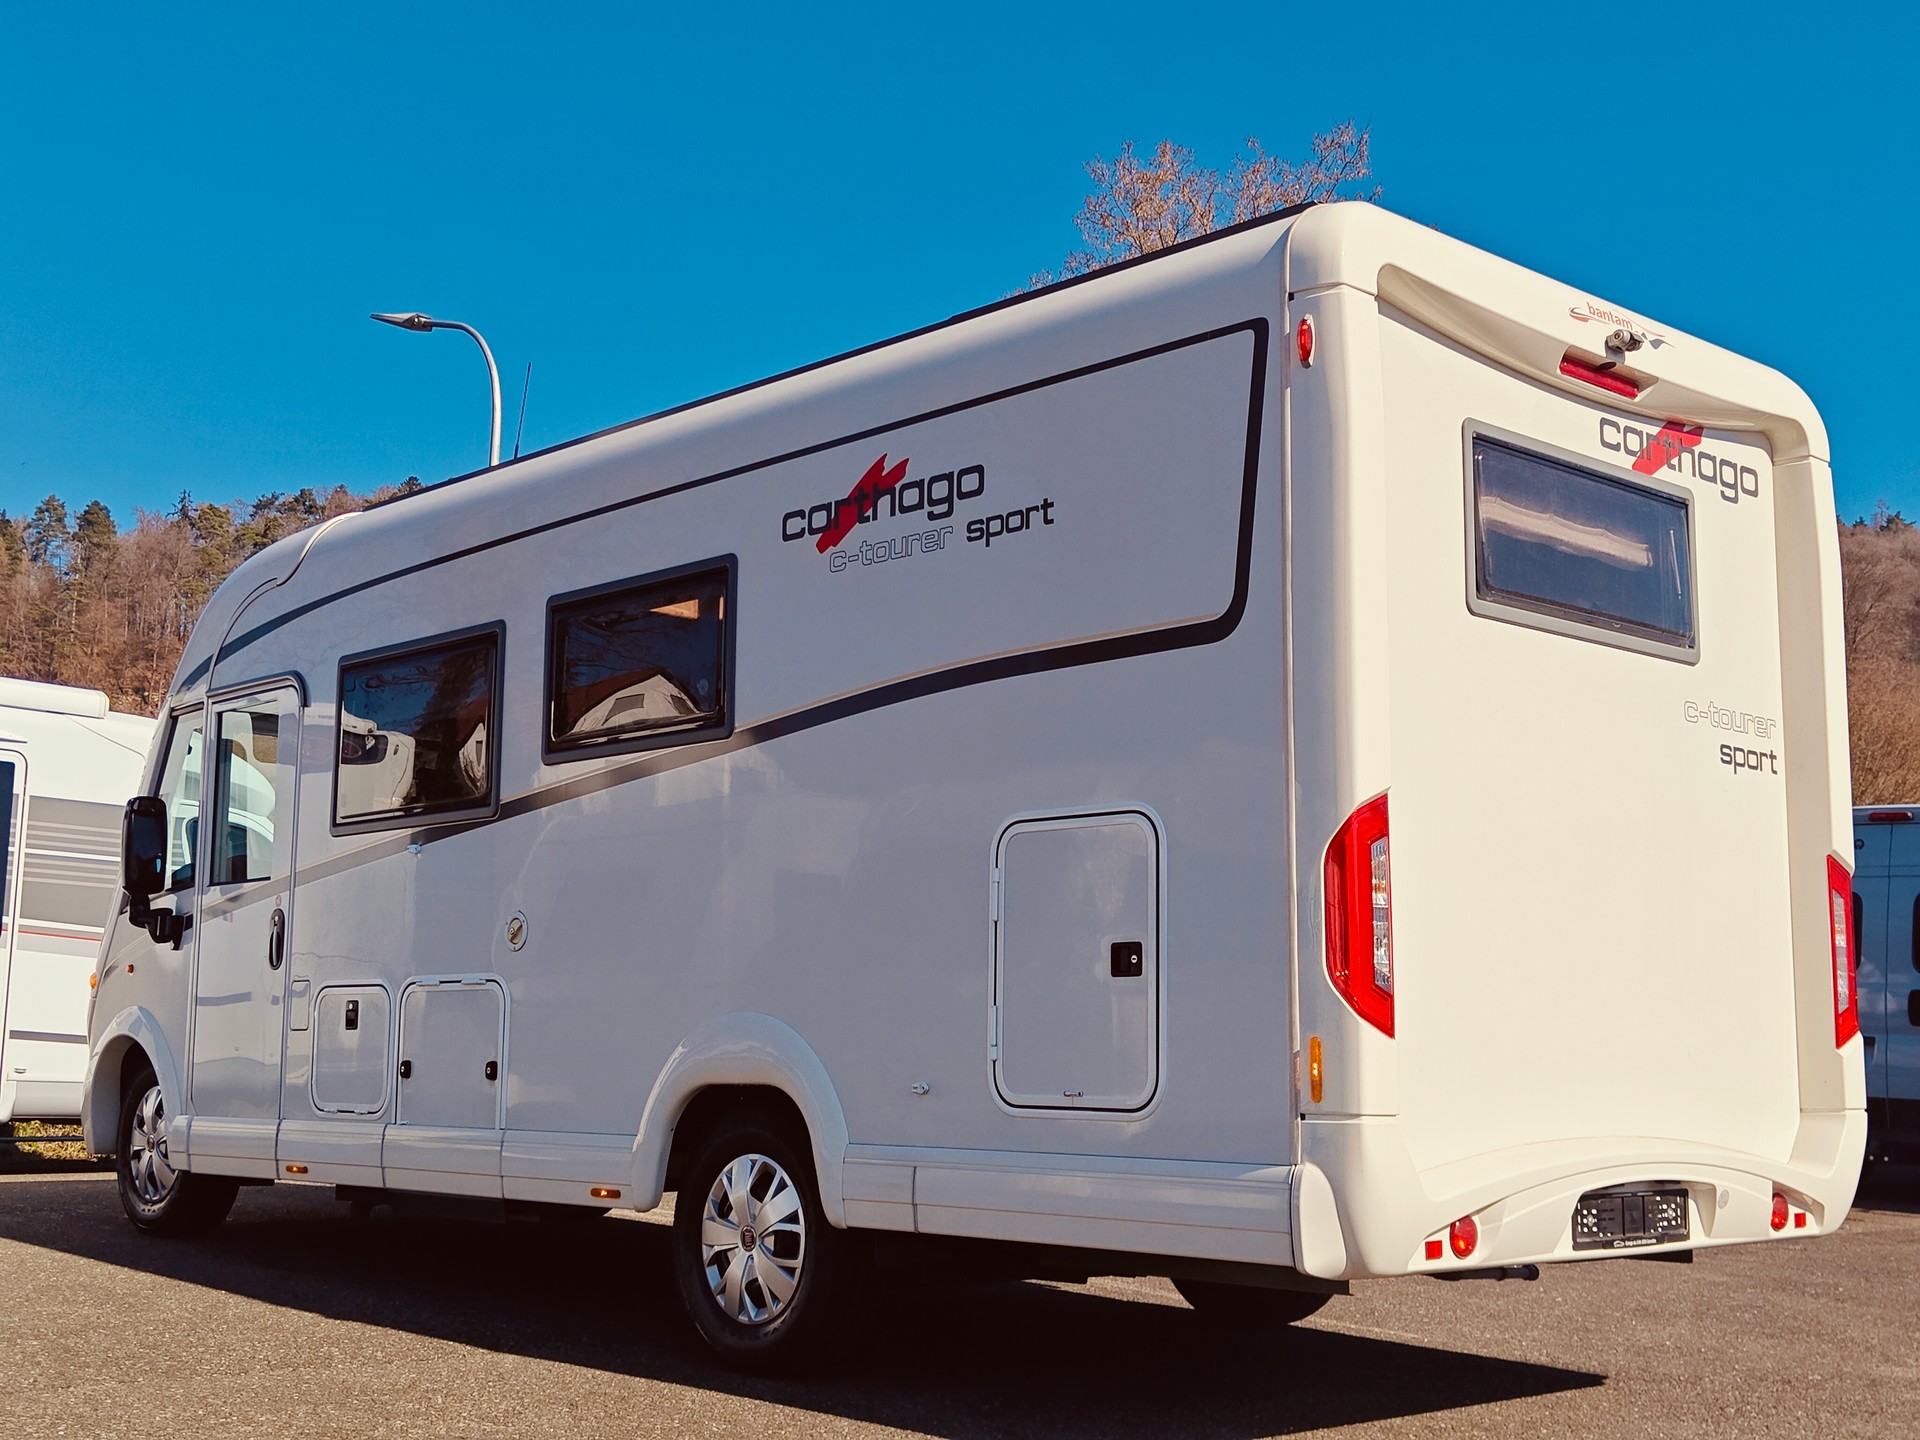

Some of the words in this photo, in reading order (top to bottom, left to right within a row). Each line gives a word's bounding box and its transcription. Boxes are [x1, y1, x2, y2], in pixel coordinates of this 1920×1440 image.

[1586, 301, 1633, 330] bantam
[1600, 417, 1759, 504] carthago
[782, 464, 984, 542] carthago
[829, 526, 953, 573] c-tourer
[966, 498, 1055, 547] sport
[1684, 700, 1776, 739] c-tourer
[1720, 743, 1778, 775] sport
